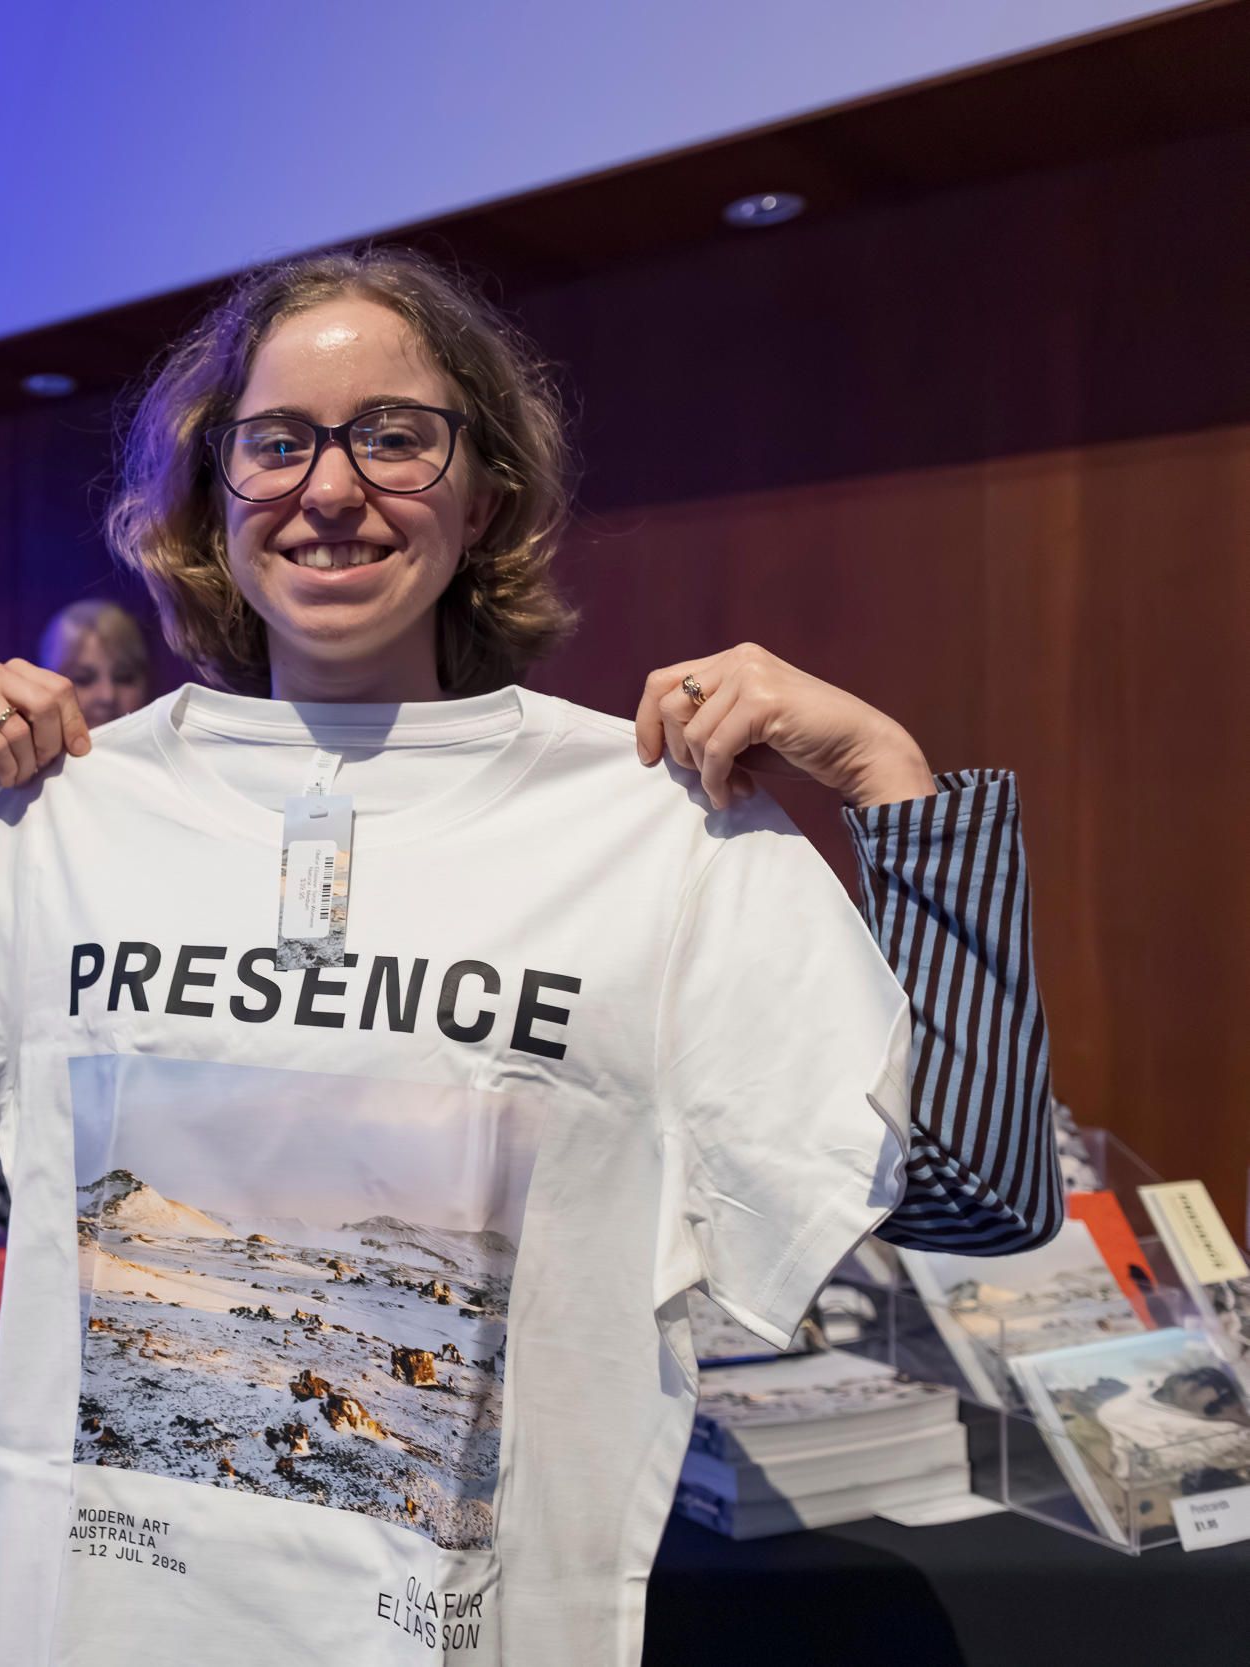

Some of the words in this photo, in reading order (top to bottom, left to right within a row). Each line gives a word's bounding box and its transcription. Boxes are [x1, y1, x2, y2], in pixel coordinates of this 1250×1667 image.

[68, 941, 582, 1060] PRESENCE
[69, 1526, 156, 1549] AUSTRALIA
[78, 1508, 135, 1528] MODERN
[142, 1518, 170, 1535] ART
[89, 1544, 107, 1557] 12
[115, 1547, 144, 1563] JUL
[152, 1554, 186, 1574] 2026
[406, 1576, 483, 1619] OLAFUR
[378, 1592, 480, 1651] ELIASSON
